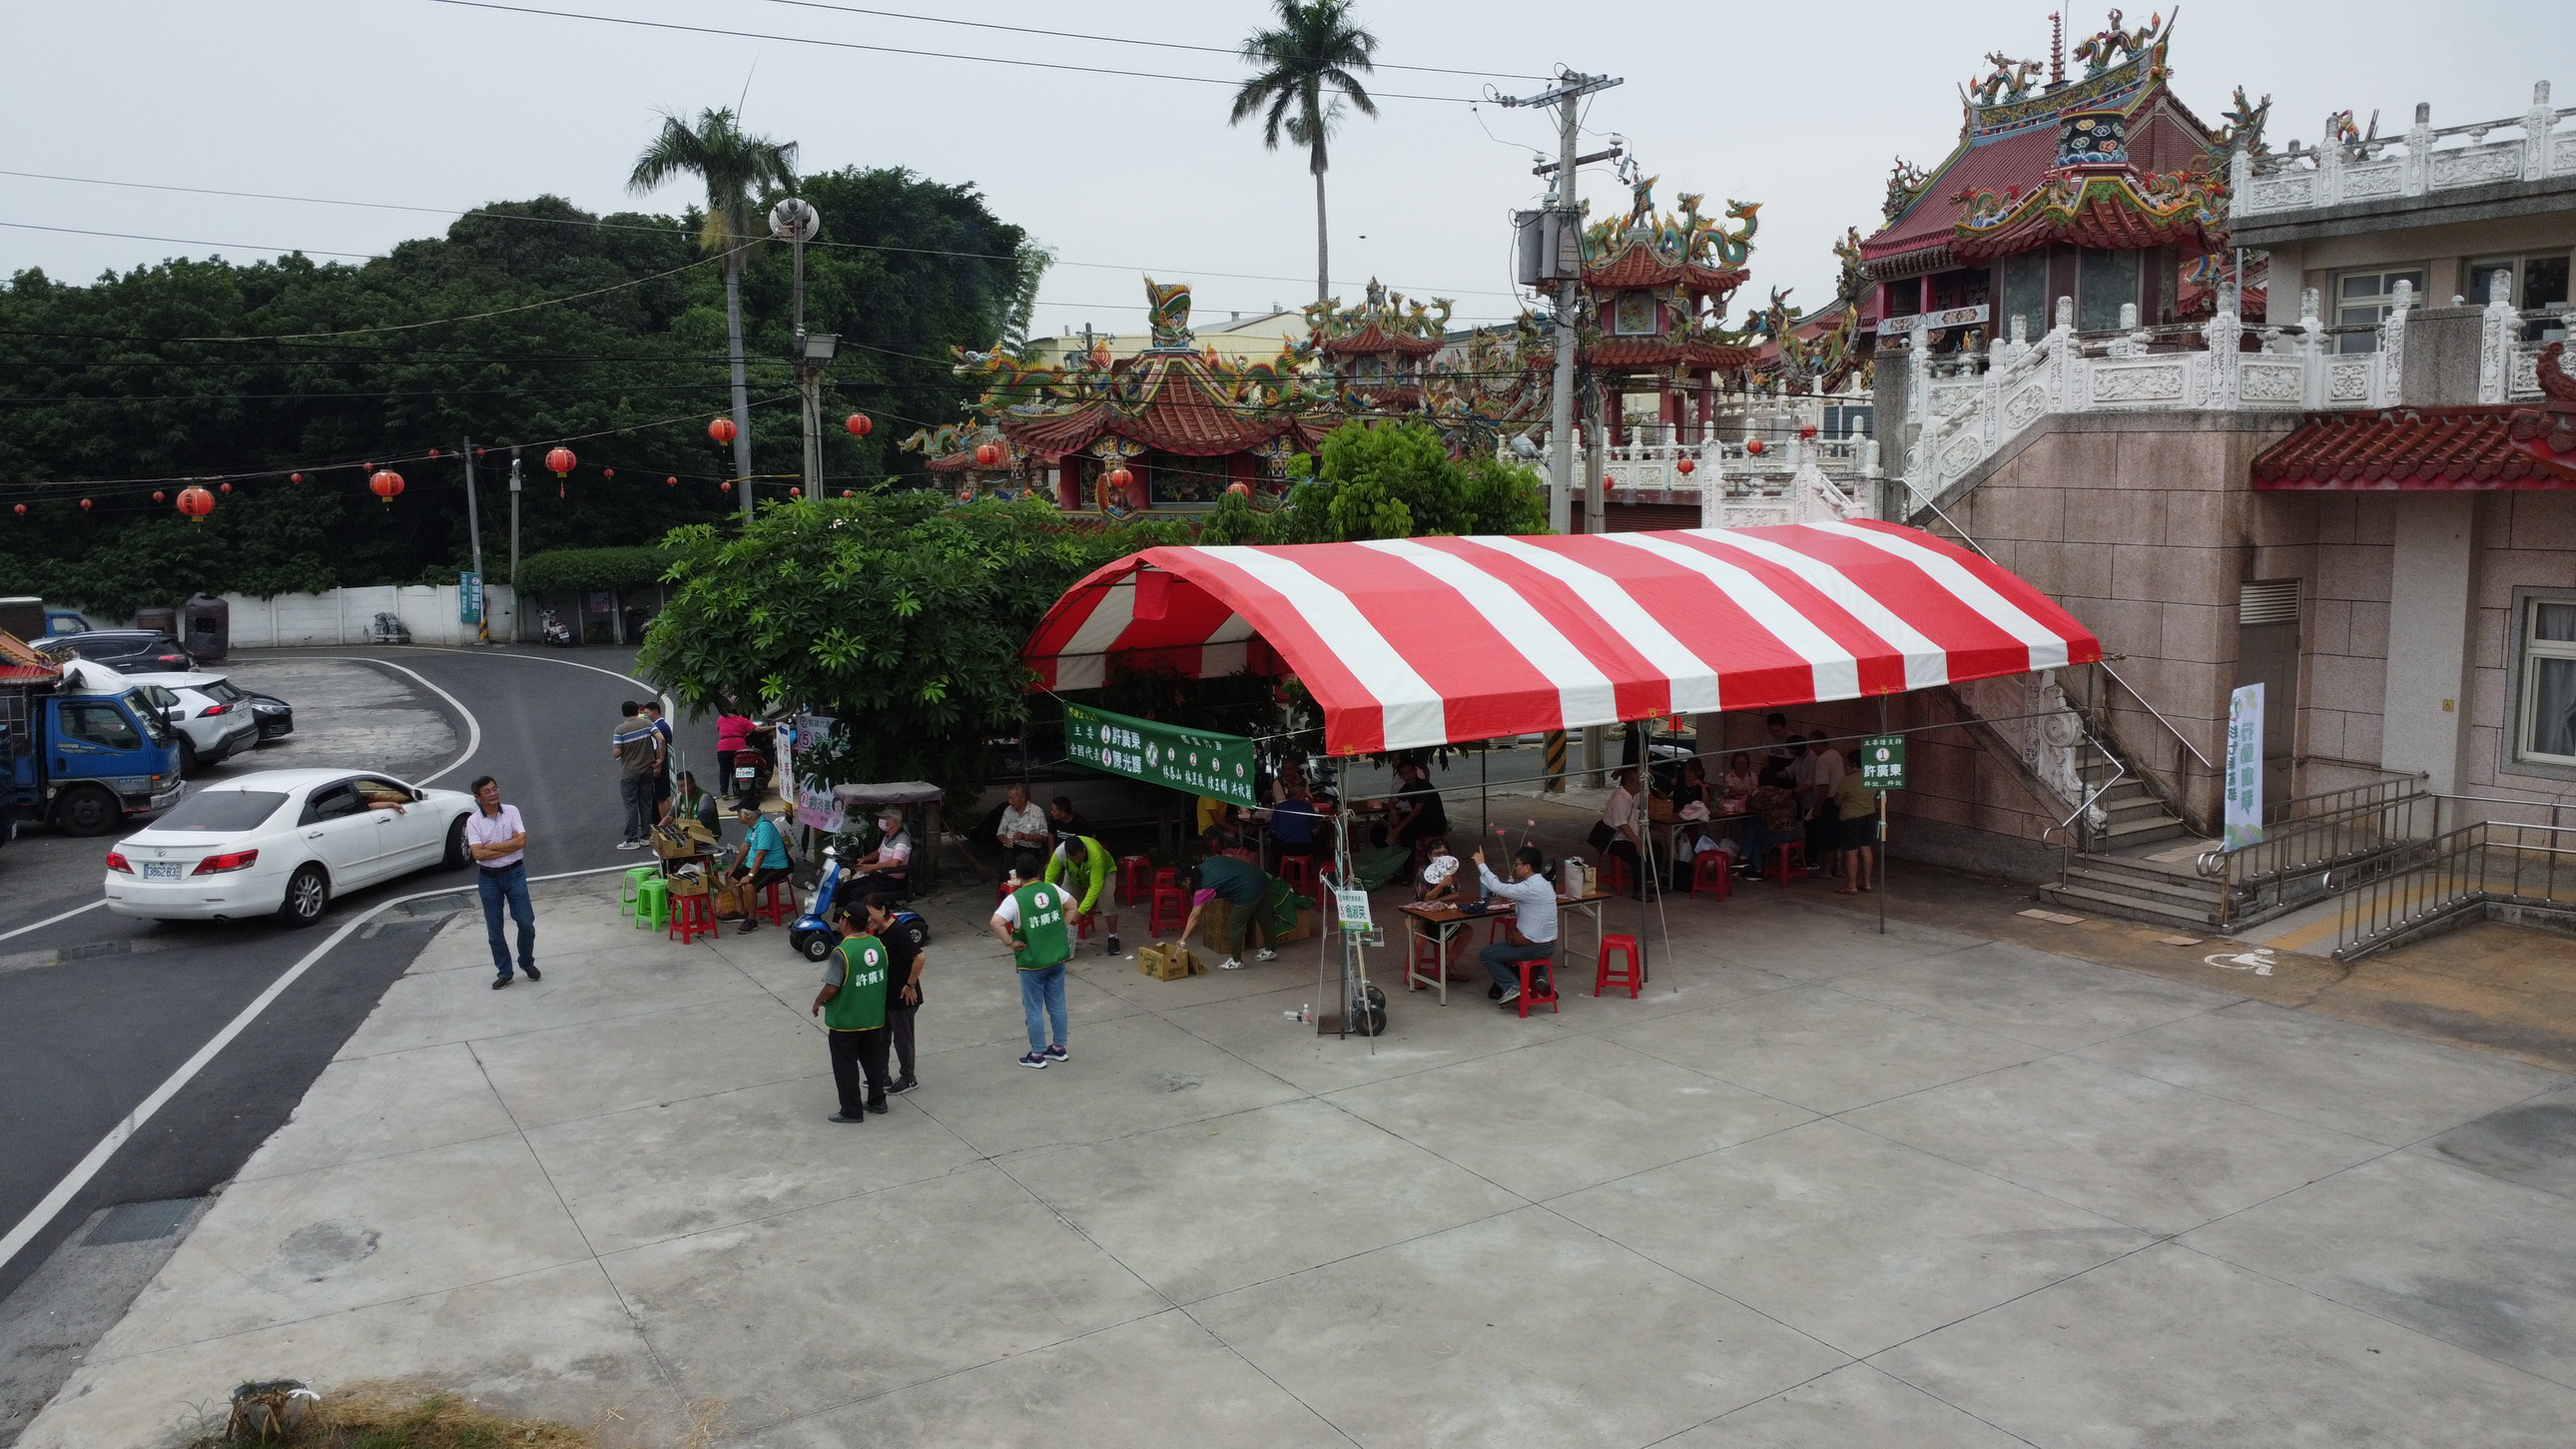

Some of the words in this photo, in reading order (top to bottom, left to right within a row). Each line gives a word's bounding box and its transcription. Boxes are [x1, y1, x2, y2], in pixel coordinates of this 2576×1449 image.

[1074, 724, 1094, 740] 主委
[1112, 726, 1141, 750] 許廣東
[1070, 742, 1100, 761] 全國代表
[1112, 750, 1142, 774] 陳光輝
[1864, 764, 1901, 777] 許廣東
[1029, 910, 1060, 929] 許廣東
